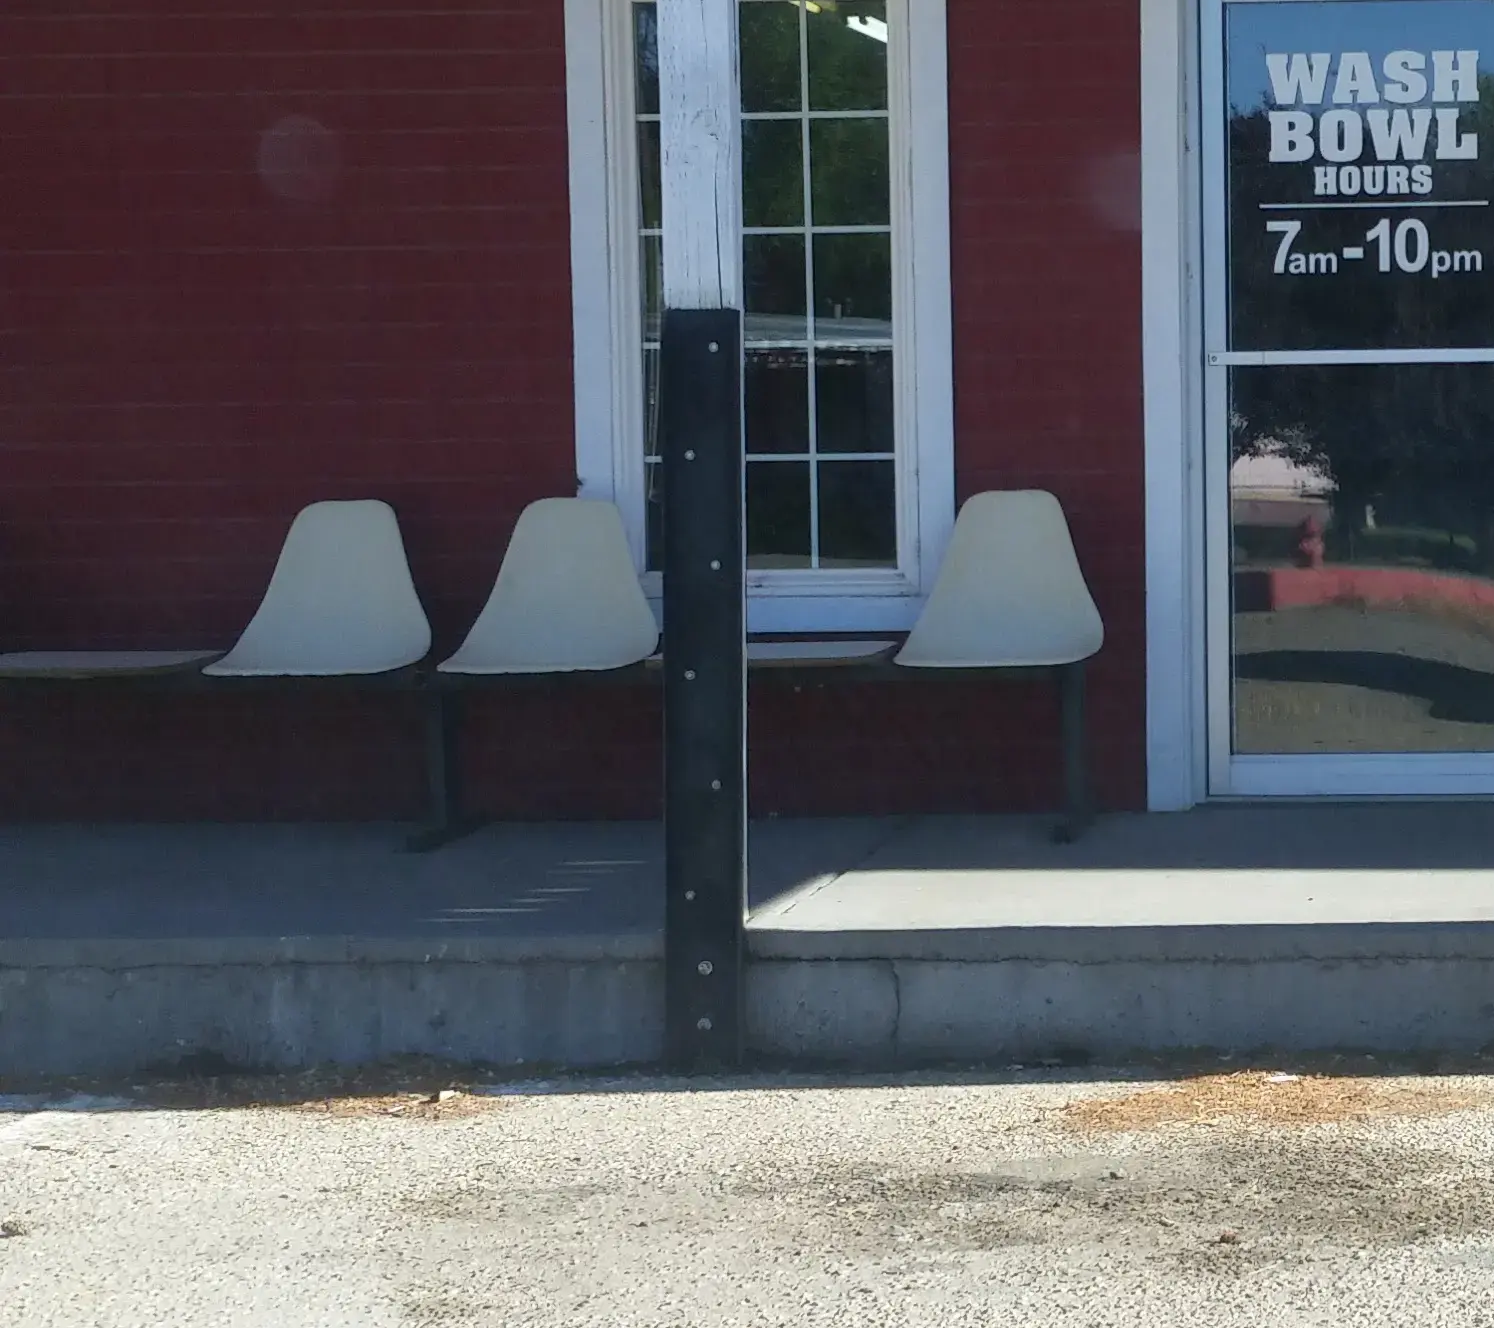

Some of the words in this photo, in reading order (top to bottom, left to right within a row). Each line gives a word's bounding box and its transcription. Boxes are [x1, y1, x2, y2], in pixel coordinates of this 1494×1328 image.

[1265, 50, 1480, 105] WASH
[1268, 108, 1478, 162] BOWL
[1313, 164, 1433, 196] HOURS
[1265, 217, 1483, 279] 7am-10pm
